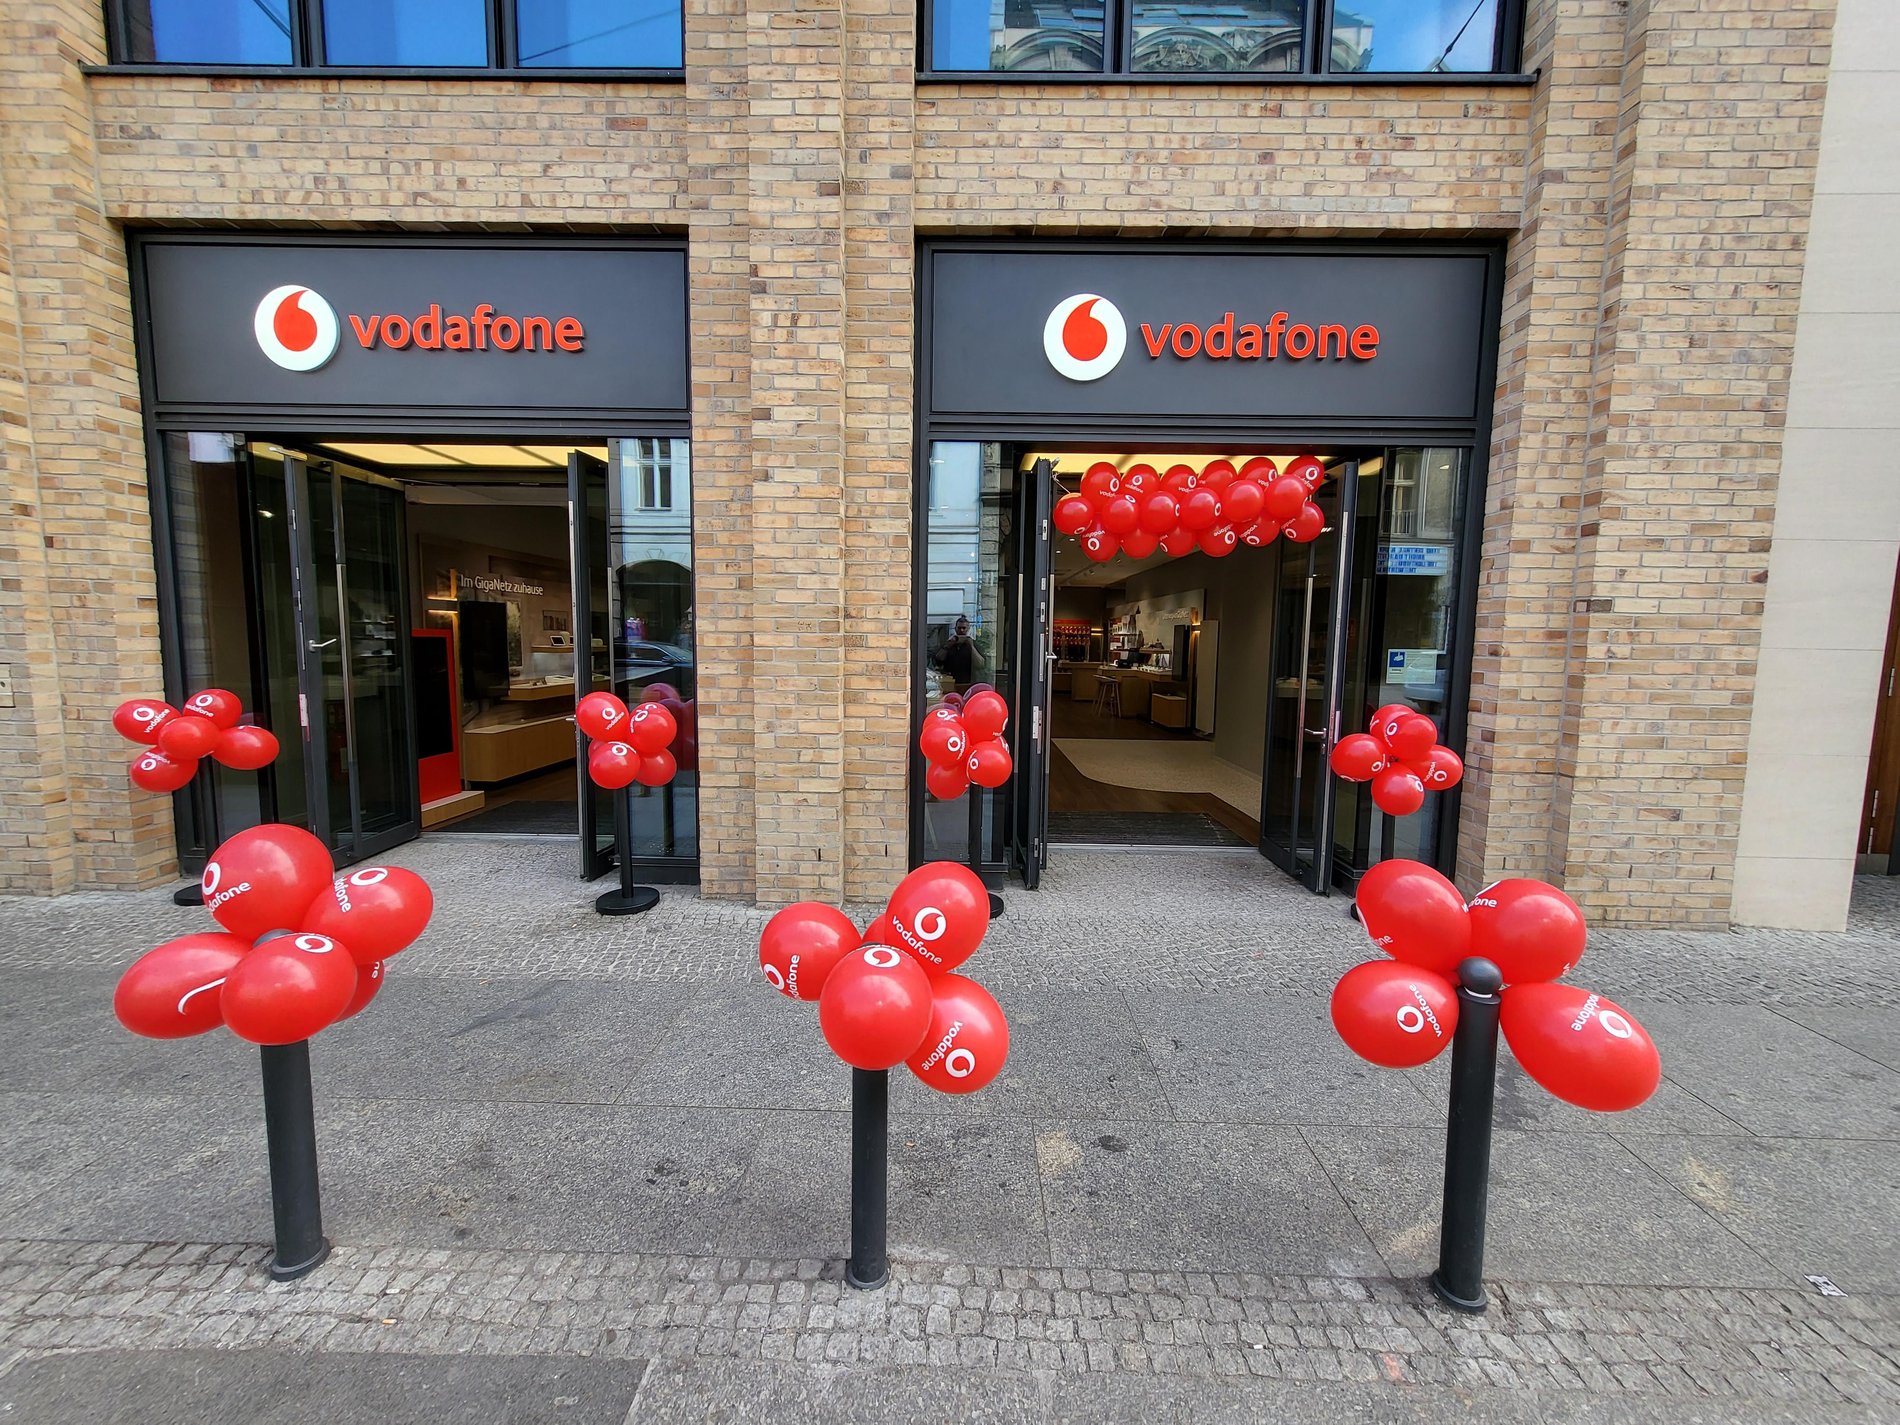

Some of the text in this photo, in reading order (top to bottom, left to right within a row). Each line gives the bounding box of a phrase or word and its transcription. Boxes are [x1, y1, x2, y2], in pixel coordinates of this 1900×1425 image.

[349, 304, 585, 352] vodafone
[1140, 312, 1380, 360] vodafone
[461, 574, 544, 595] Im GigaNetz zuhause
[893, 915, 942, 965] vodafone
[1409, 984, 1442, 1038] vodafone
[921, 1021, 963, 1071] vodafone
